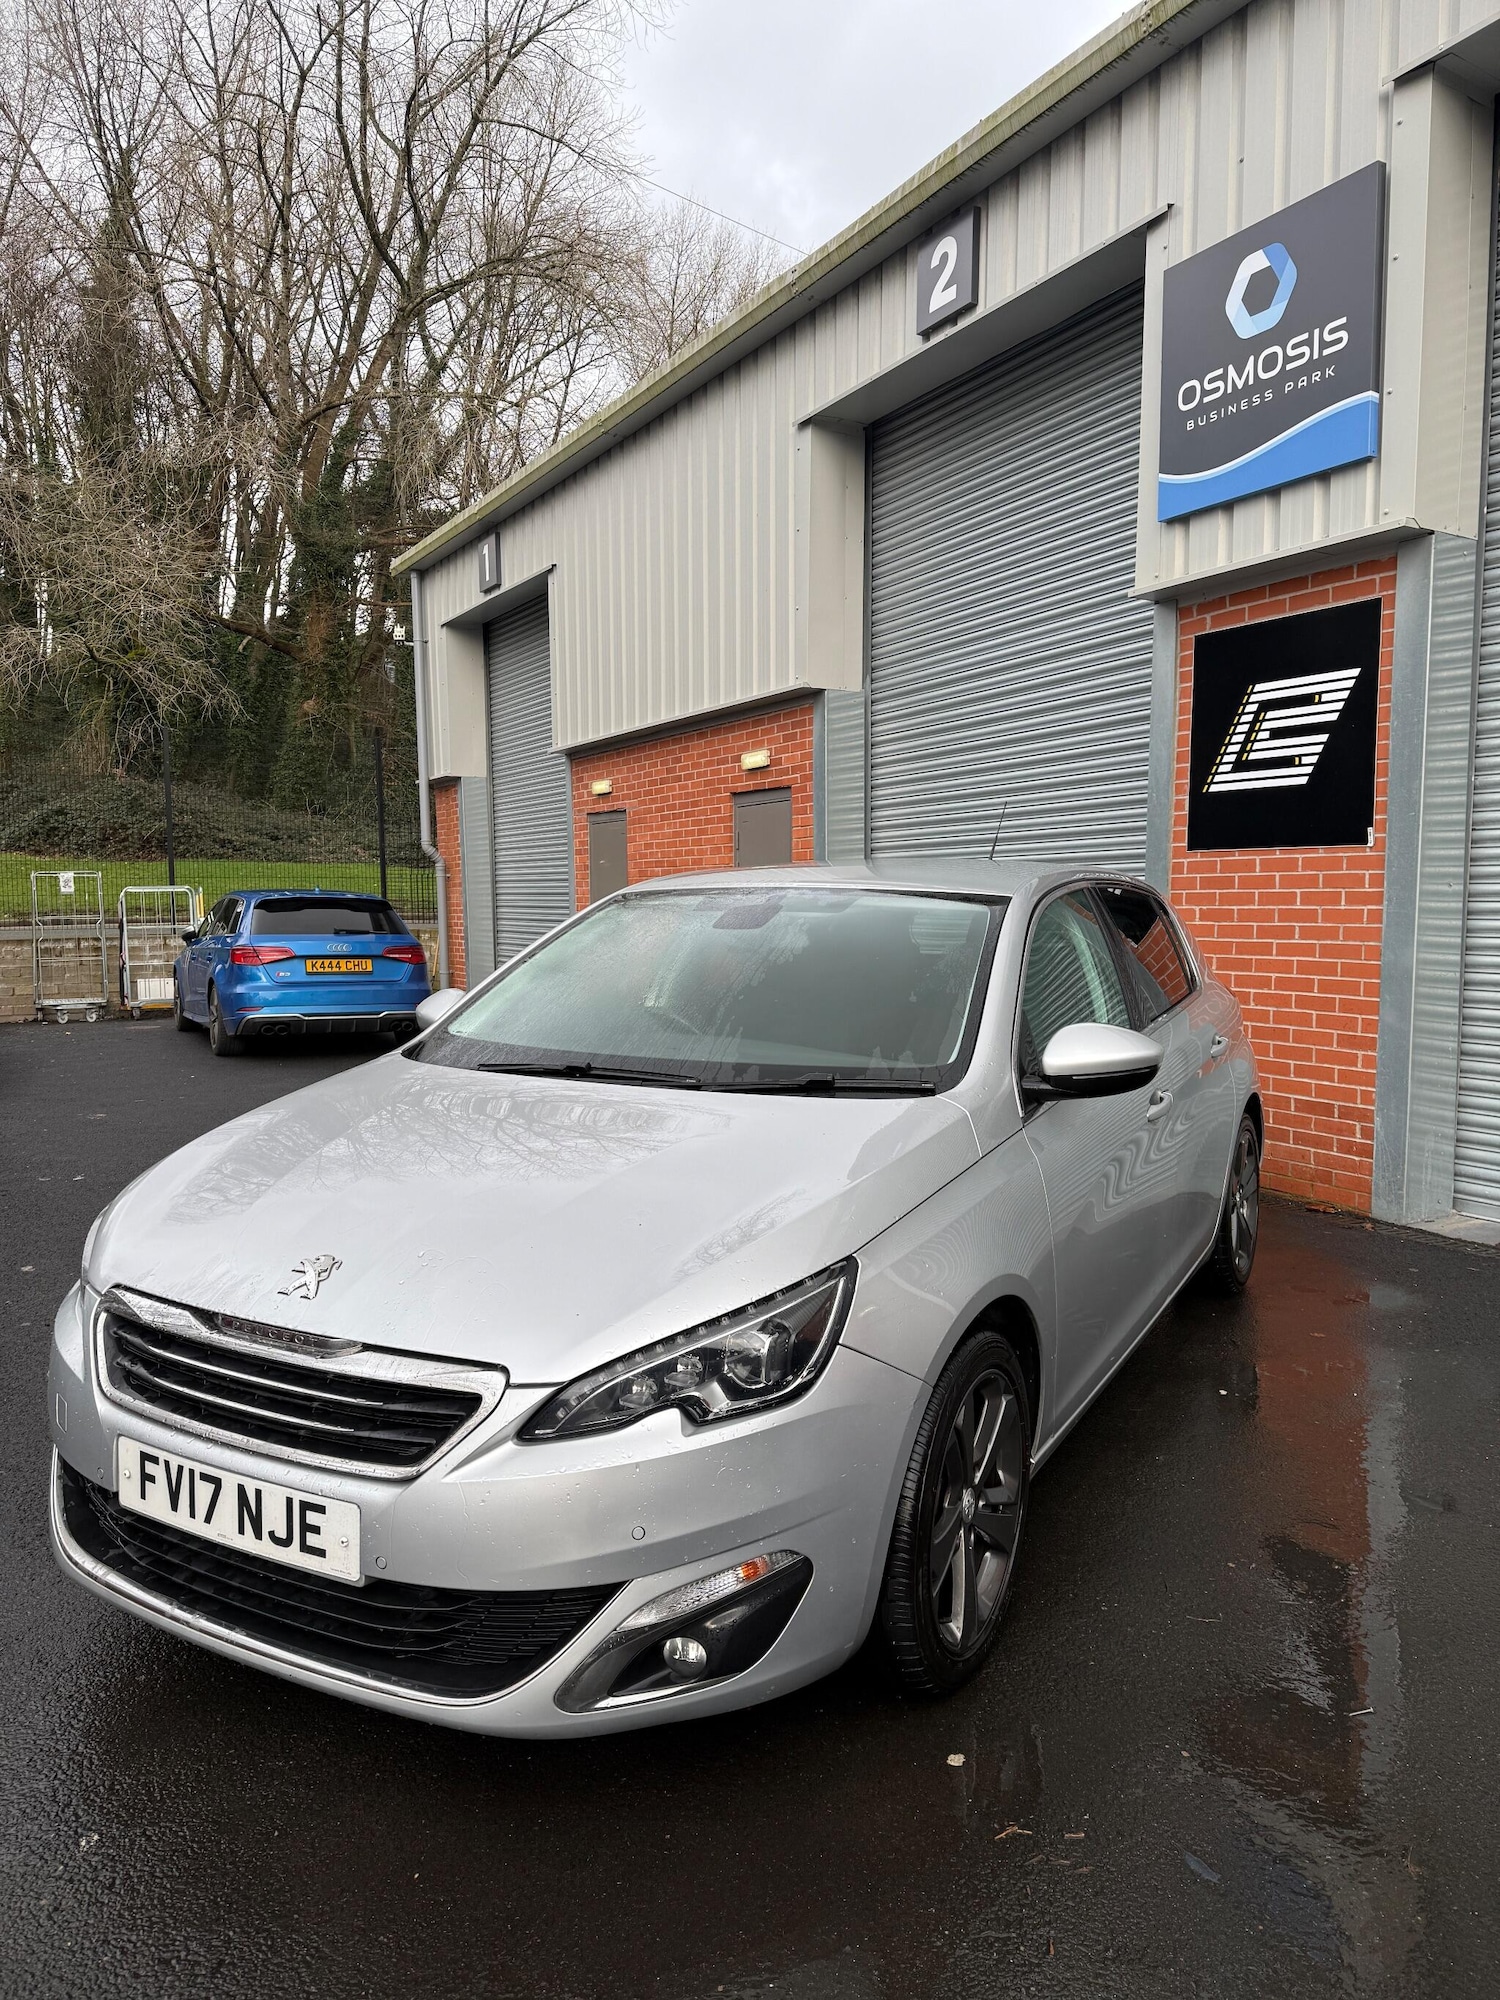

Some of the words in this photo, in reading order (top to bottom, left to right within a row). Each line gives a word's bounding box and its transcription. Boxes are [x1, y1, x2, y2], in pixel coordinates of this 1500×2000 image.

[929, 236, 957, 313] 2
[1177, 316, 1349, 412] OSMOSIS
[1186, 389, 1274, 431] BUSINESS
[1284, 364, 1336, 394] PARK
[482, 544, 489, 581] 1
[311, 960, 342, 971] K444
[345, 960, 368, 971] CHU
[139, 1450, 222, 1525] FV17
[237, 1483, 327, 1559] NJE
